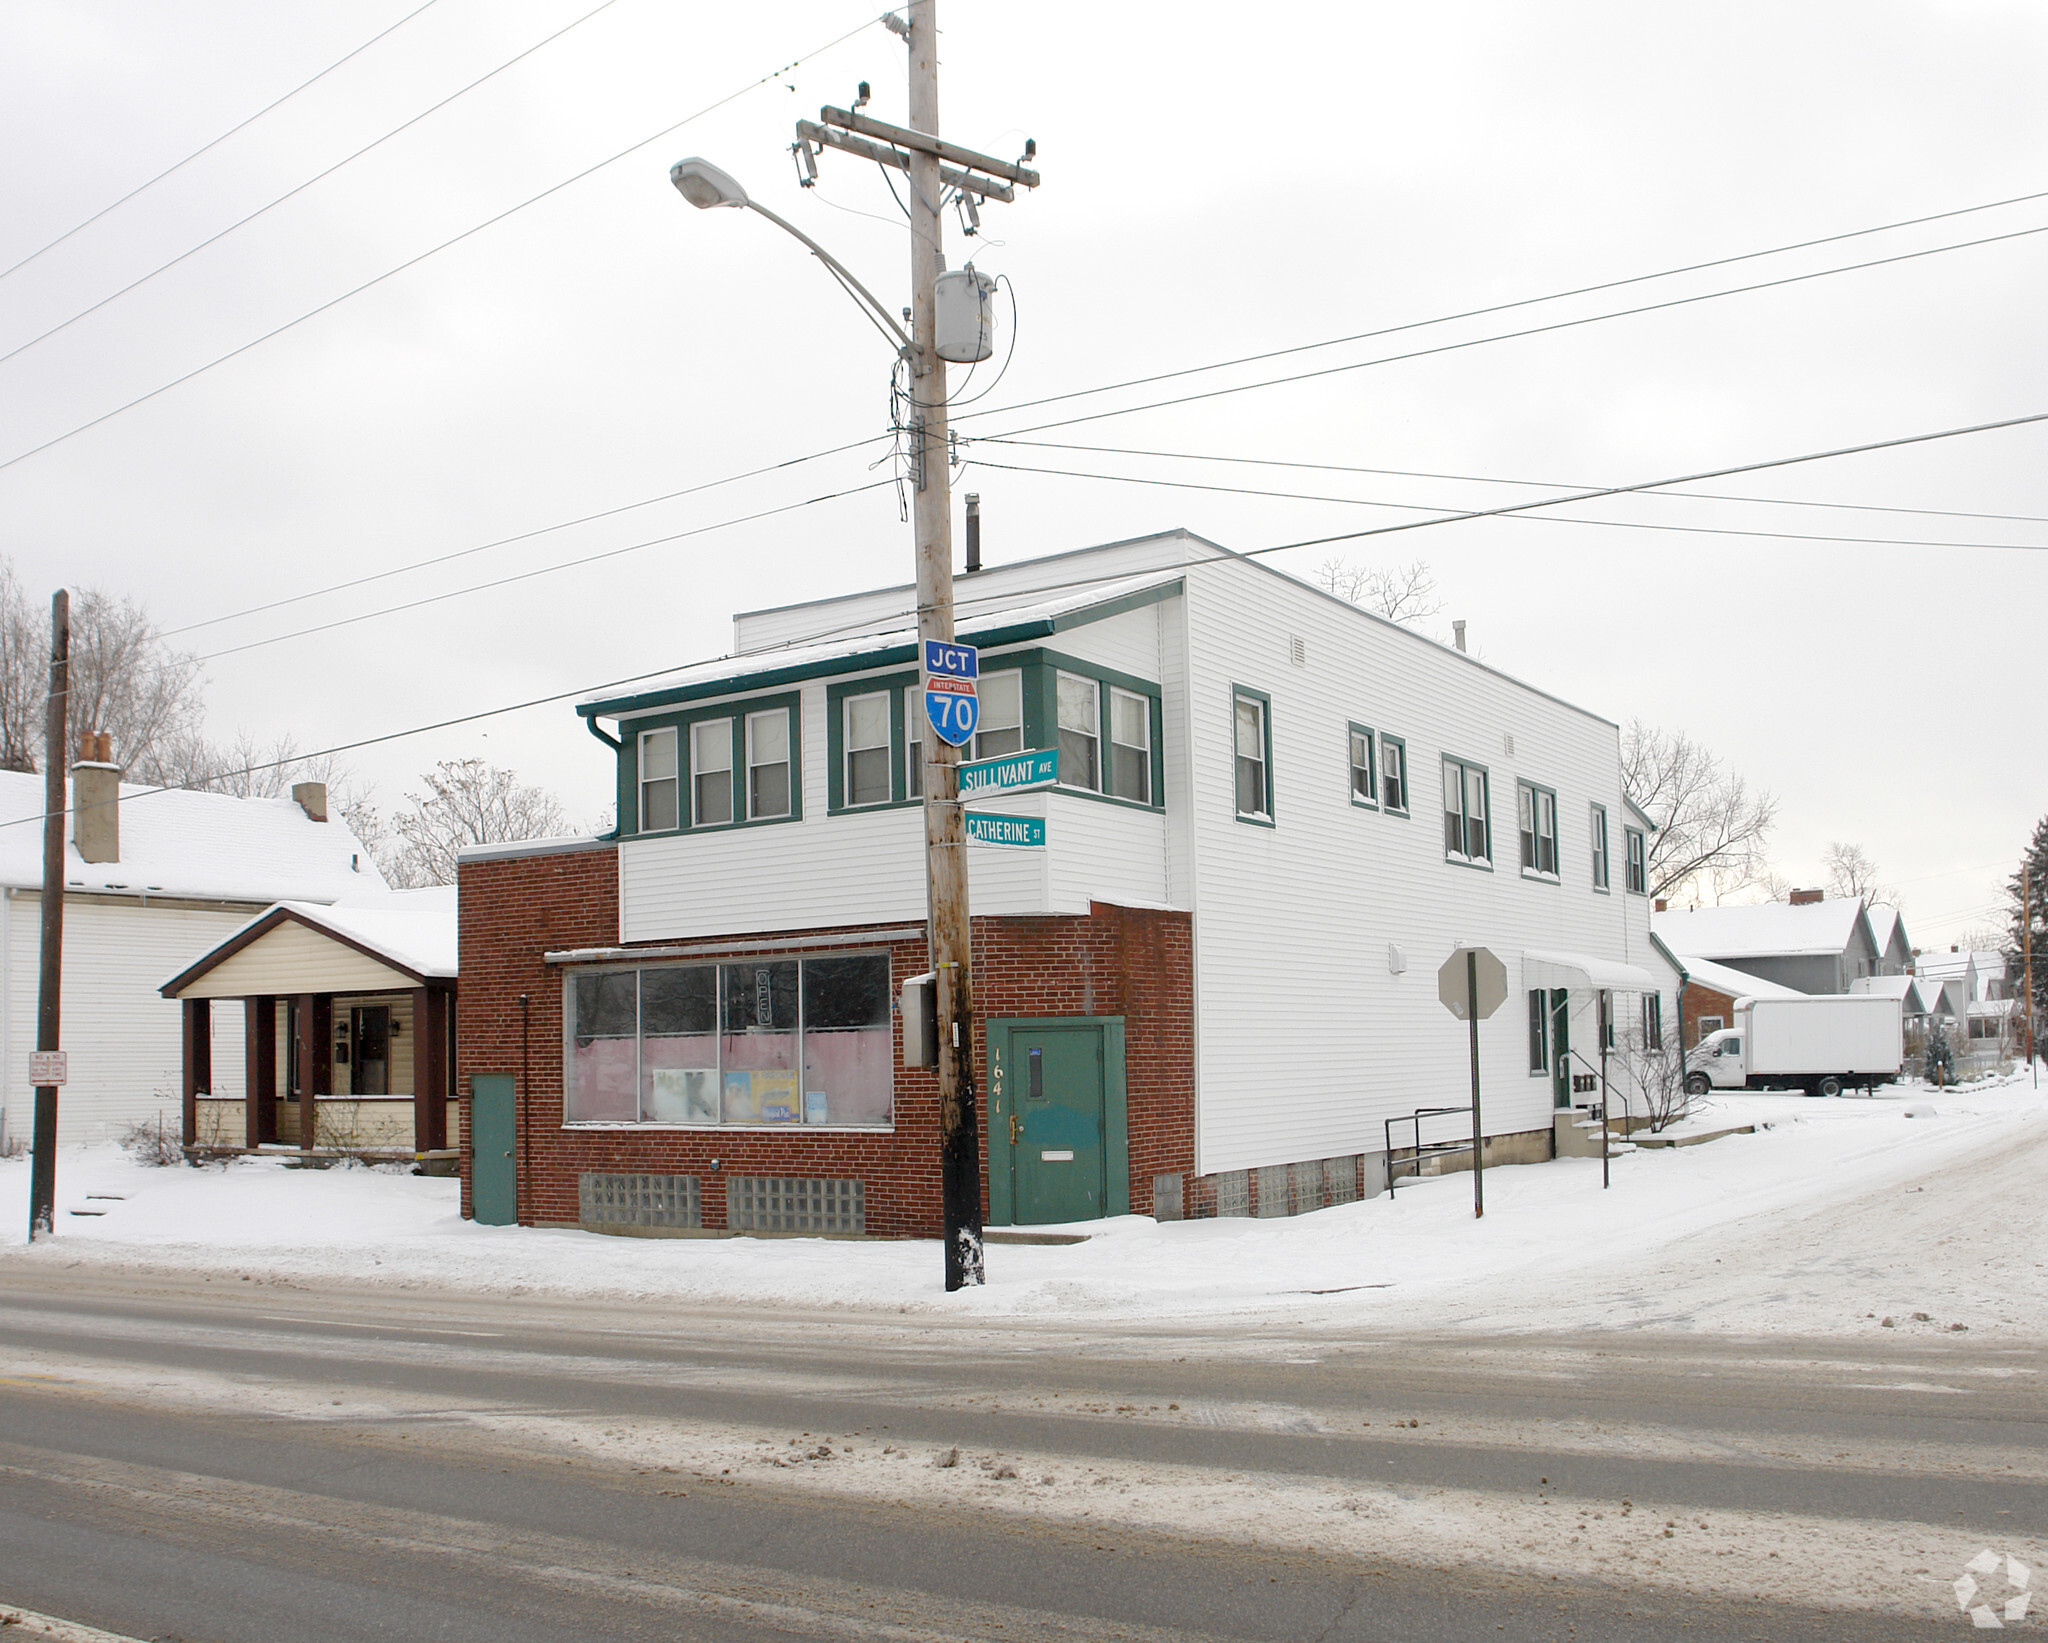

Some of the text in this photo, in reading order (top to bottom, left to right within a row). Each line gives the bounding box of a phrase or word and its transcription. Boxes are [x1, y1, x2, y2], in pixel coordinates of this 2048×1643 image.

[932, 648, 969, 671] JCT
[933, 681, 970, 692] INTERSTATE
[934, 696, 972, 731] 70
[965, 760, 1052, 791] SULLIVANT AVE
[968, 819, 1040, 842] CATHERINE ST
[759, 973, 770, 1022] OPEN
[993, 1048, 1004, 1114] 1641
